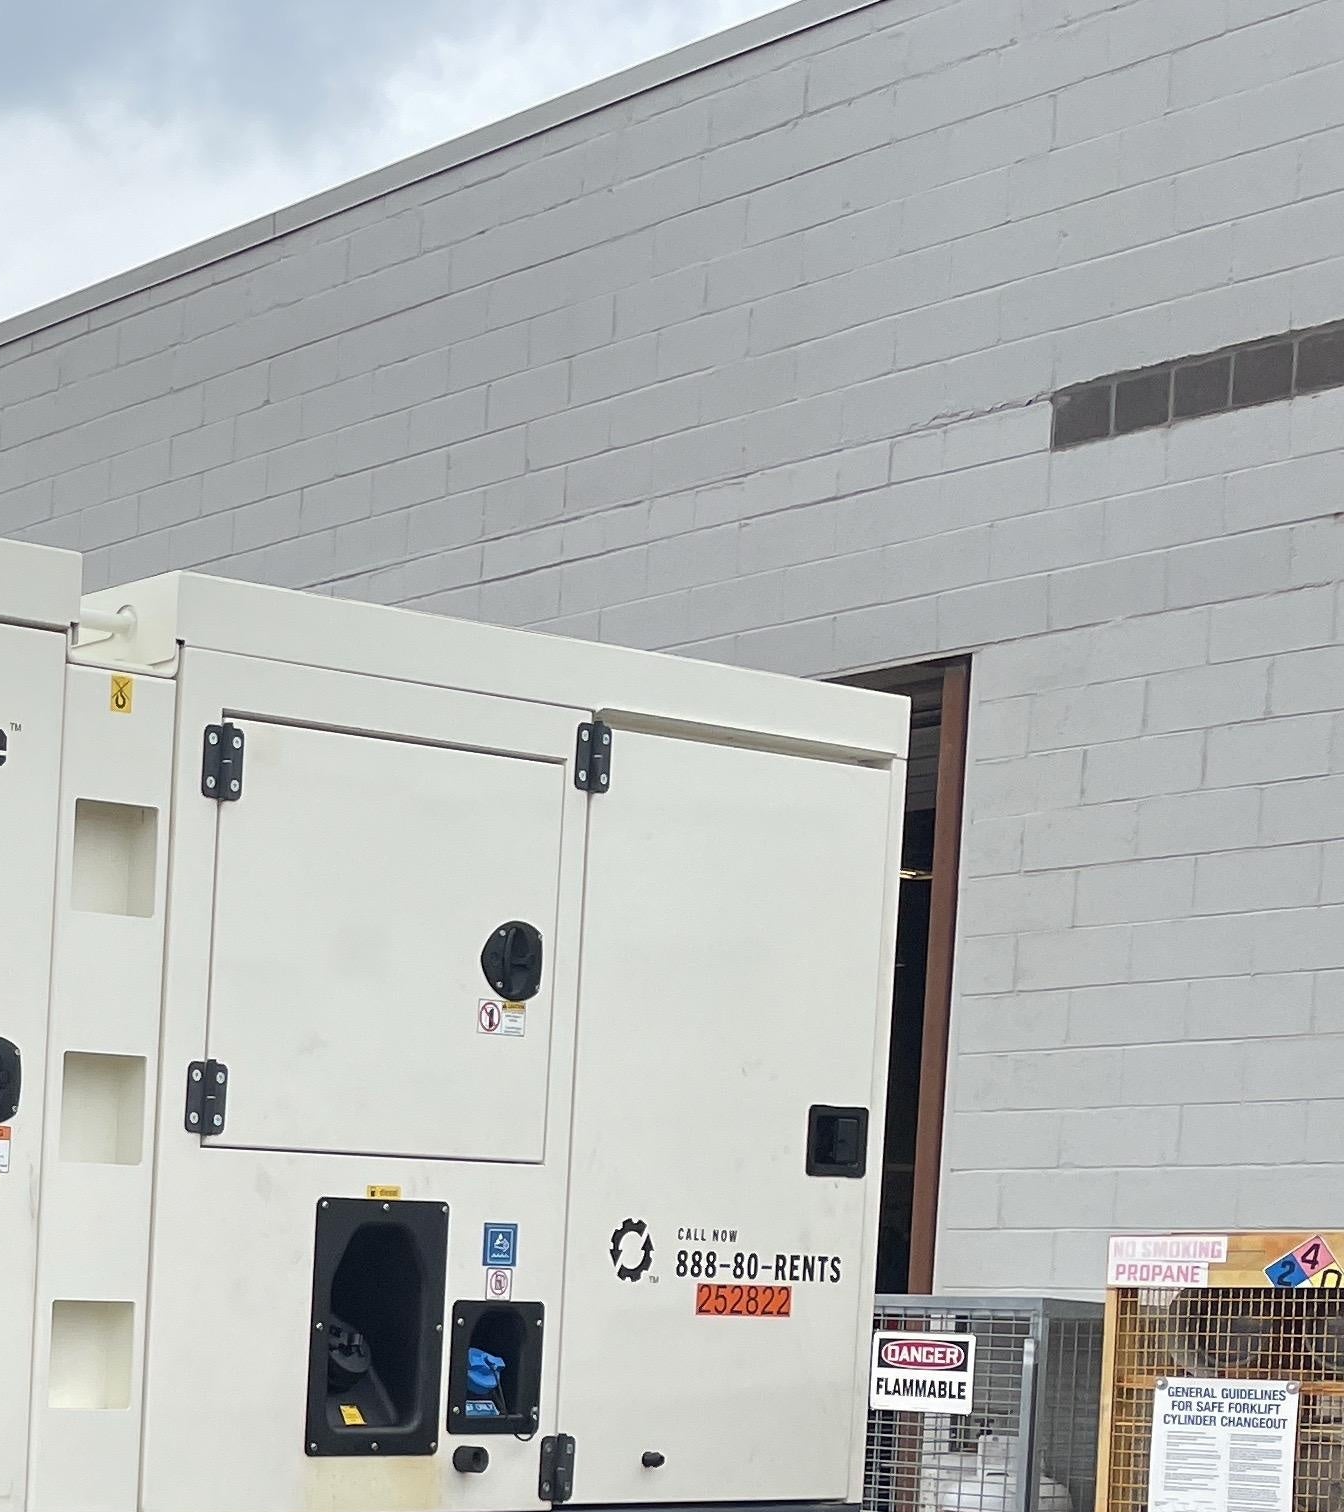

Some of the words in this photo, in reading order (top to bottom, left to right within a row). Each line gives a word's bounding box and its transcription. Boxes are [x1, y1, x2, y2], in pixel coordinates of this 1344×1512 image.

[677, 1228, 707, 1242] CALL
[712, 1229, 738, 1243] NOW
[1112, 1240, 1137, 1259] NO
[1140, 1240, 1223, 1259] SMOKING
[1300, 1243, 1321, 1270] 4
[675, 1249, 842, 1284] 888-80-RENTS
[1114, 1263, 1202, 1284] PROPANE
[1276, 1259, 1296, 1287] 2
[697, 1283, 792, 1317] 252822
[886, 1345, 960, 1365] DANGER
[875, 1376, 968, 1400] FLAMMABLE
[1167, 1386, 1217, 1398] GENERAL
[1221, 1388, 1287, 1401] GUIDELINES
[1171, 1400, 1193, 1411] FOR
[1196, 1401, 1225, 1413] SAFE
[1228, 1403, 1282, 1415] FORKLIFT
[1163, 1413, 1217, 1427] CYLINDER
[1220, 1417, 1289, 1430] CHANGEOUT
